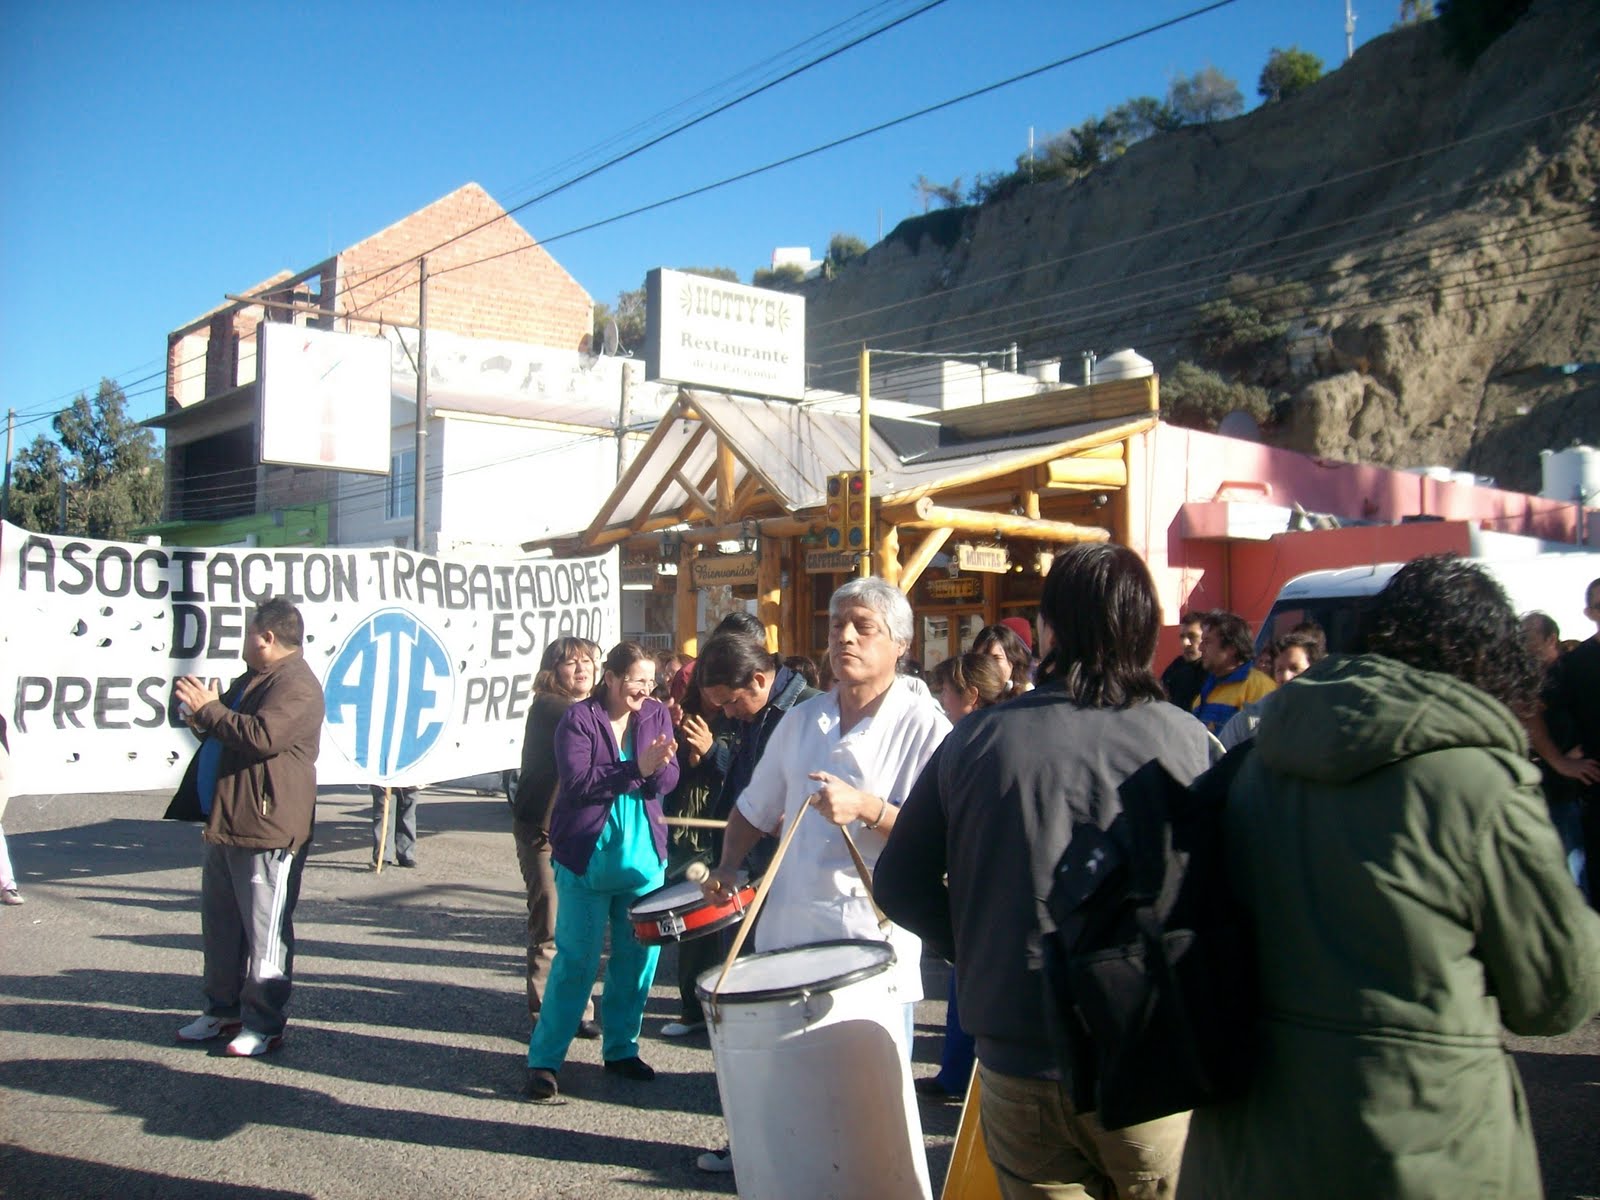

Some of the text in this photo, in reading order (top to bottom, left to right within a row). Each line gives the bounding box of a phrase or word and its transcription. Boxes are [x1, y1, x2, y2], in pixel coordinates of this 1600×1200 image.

[696, 285, 775, 328] HOTTY'S
[681, 331, 790, 364] Restaurante
[18, 535, 610, 611] ASOCIACION TRABAJADORES
[324, 610, 451, 776] ATE
